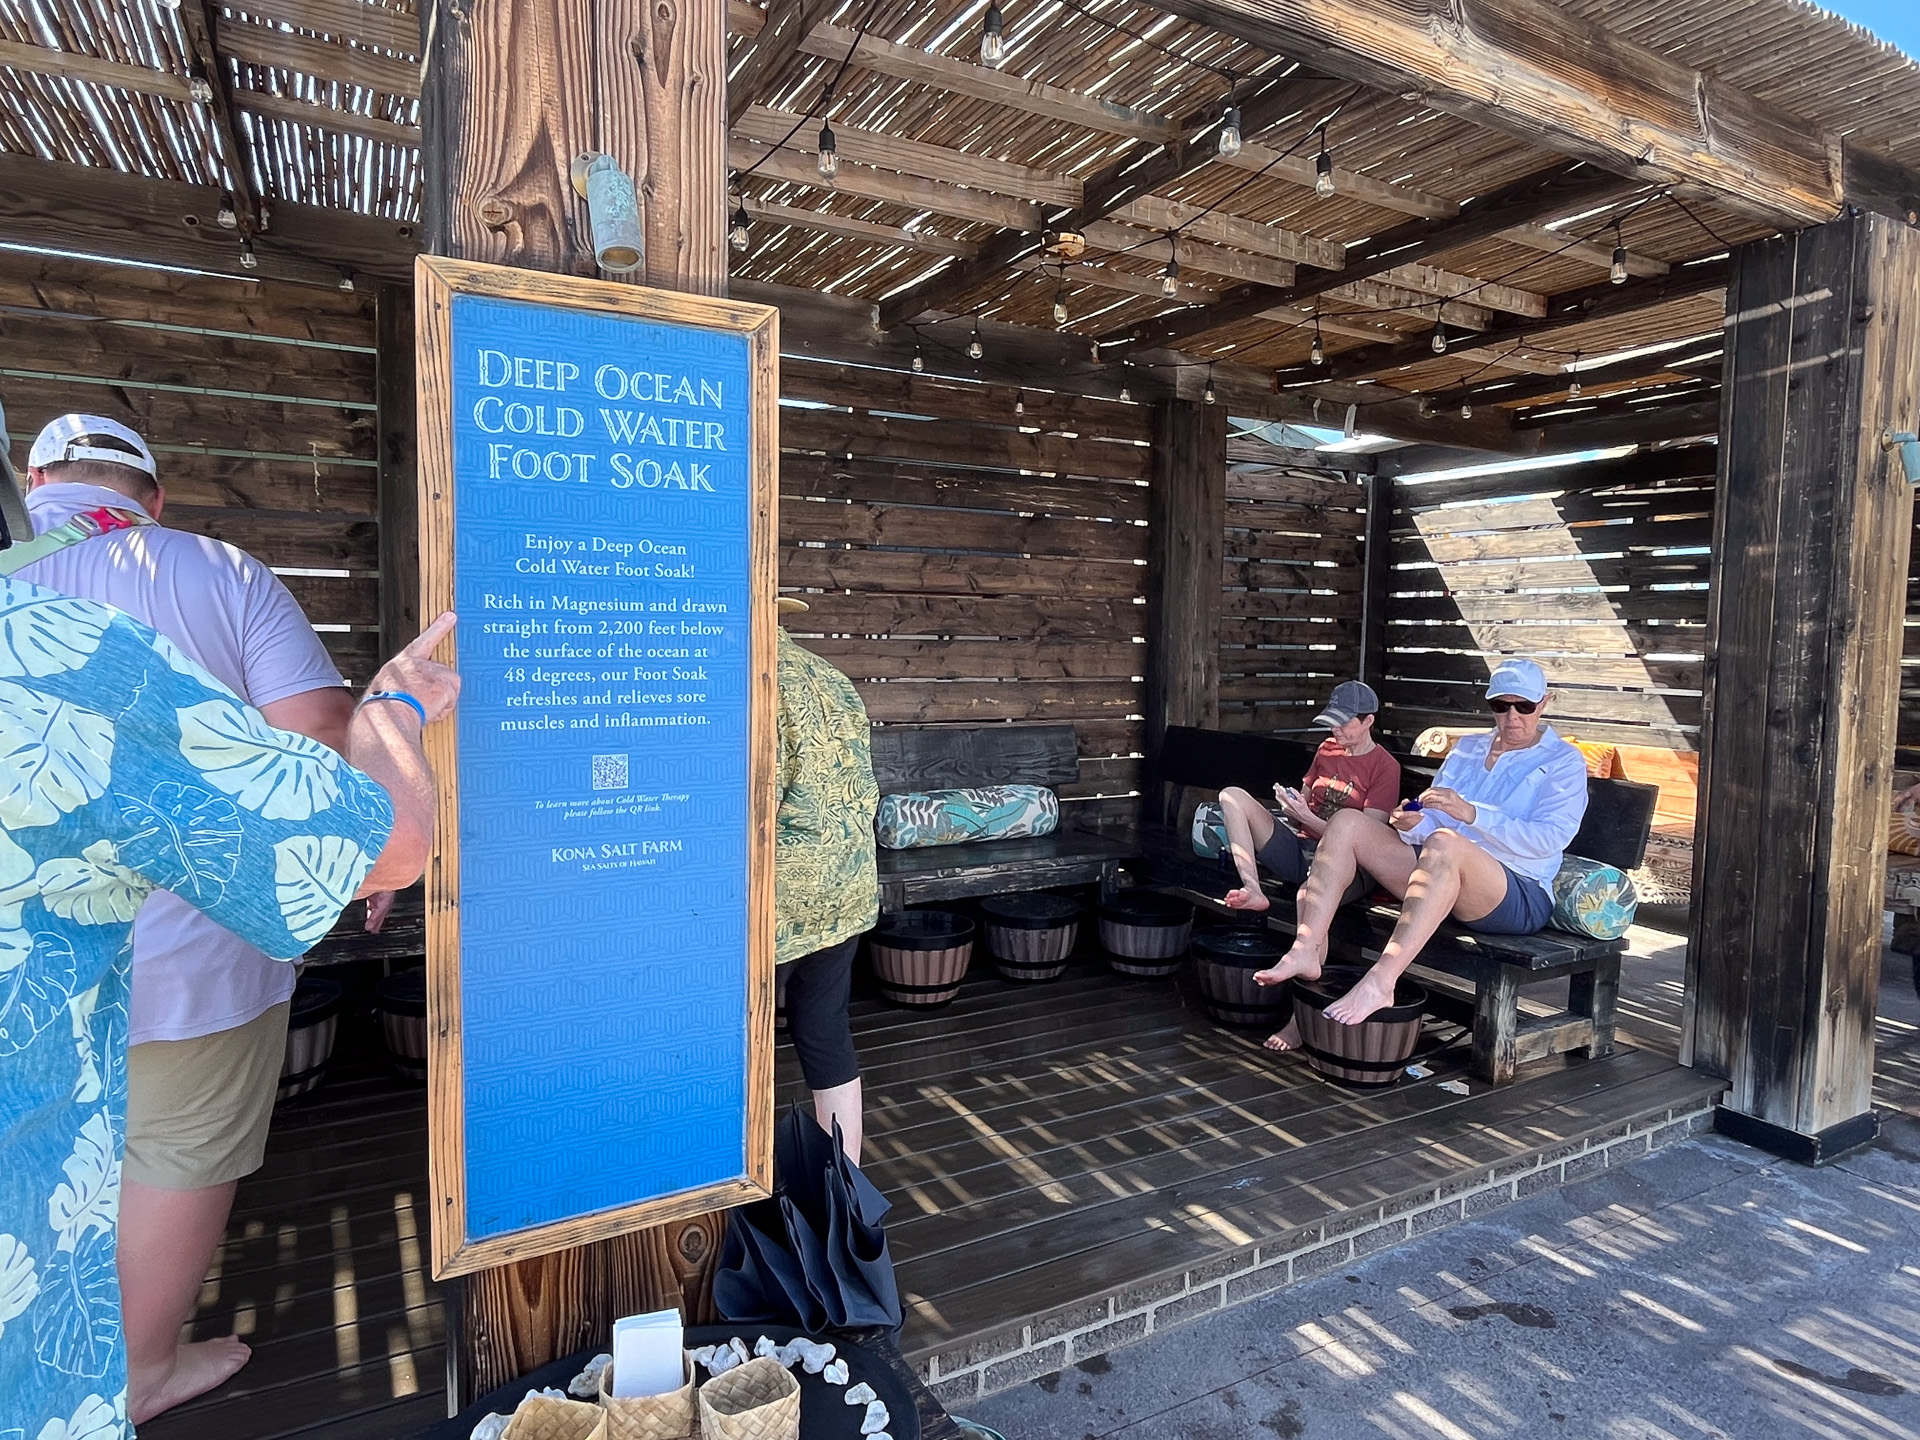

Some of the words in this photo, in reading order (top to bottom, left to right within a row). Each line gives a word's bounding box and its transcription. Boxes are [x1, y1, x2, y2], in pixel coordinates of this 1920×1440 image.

[478, 349, 579, 391] DEEP
[595, 364, 722, 409] OCEAN
[473, 396, 584, 437] COLD
[599, 408, 727, 451] WATER
[489, 443, 596, 482] FOOT
[610, 453, 716, 492] SOAK
[525, 534, 573, 554] Enjoy
[578, 541, 587, 550] a
[592, 537, 633, 557] Deep
[638, 540, 686, 555] Ocean
[516, 558, 556, 573] Cold
[561, 560, 609, 575] Water
[615, 562, 649, 577] Foot
[655, 563, 694, 578] Soak!
[484, 594, 523, 609] Rich
[530, 596, 545, 609] in
[552, 596, 644, 615] Magnesium
[650, 598, 677, 612] and
[682, 598, 727, 612] drawn
[484, 619, 548, 638] straight
[554, 619, 592, 634] from
[599, 621, 643, 636] 2,200
[649, 620, 675, 634] feet
[681, 621, 724, 635] below
[503, 643, 529, 658] the
[535, 643, 592, 657] surface
[597, 643, 615, 657] of
[618, 643, 642, 657] the
[647, 649, 689, 657] ocean
[694, 648, 708, 657] at
[504, 667, 525, 682] 48
[532, 667, 595, 686] degrees,
[601, 672, 628, 681] our
[634, 667, 667, 680] Foot
[672, 666, 707, 680] Soak
[507, 691, 577, 706] refreshes
[583, 690, 611, 704] and
[618, 689, 672, 704] relieves
[677, 694, 706, 703] sore
[501, 715, 564, 730] muscles
[570, 713, 599, 728] and
[605, 712, 710, 727] inflammation.
[534, 801, 544, 809] To
[546, 800, 567, 809] learn
[591, 797, 614, 806] about
[616, 795, 635, 804] Cold
[637, 794, 659, 803] Water
[661, 793, 690, 802] Therapy
[563, 808, 588, 820] please
[588, 806, 614, 818] follow
[616, 806, 627, 814] the
[629, 805, 643, 814] QR
[551, 846, 596, 863] KONA
[601, 843, 638, 859] SALT
[642, 840, 683, 854] FARM
